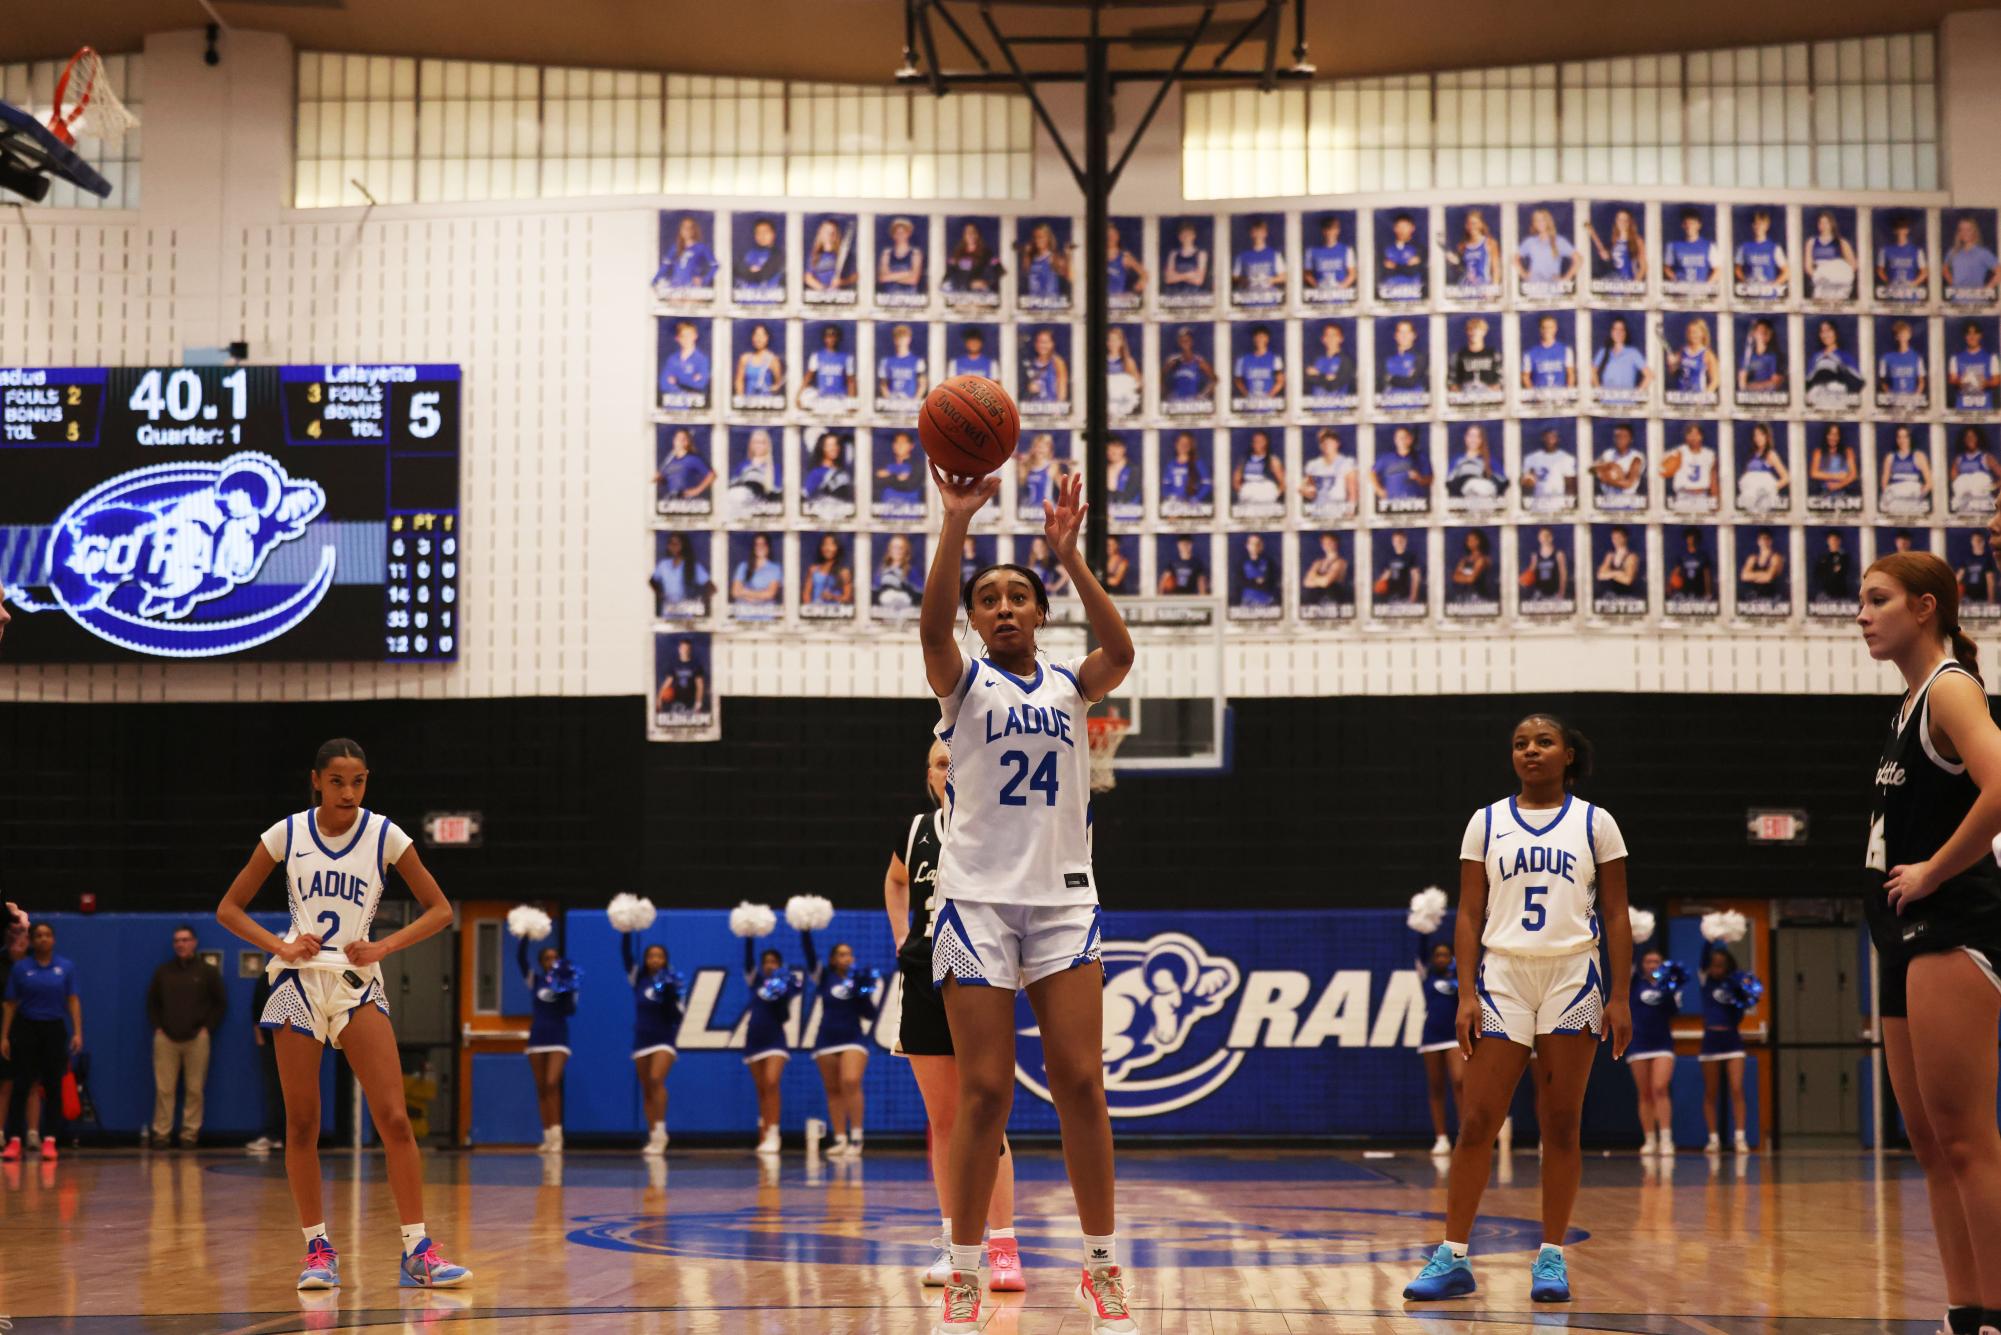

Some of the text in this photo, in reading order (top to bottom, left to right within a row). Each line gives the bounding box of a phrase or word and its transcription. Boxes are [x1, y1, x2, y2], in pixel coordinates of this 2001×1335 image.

[5, 384, 81, 405] FOULS 2
[129, 367, 246, 421] 40.1
[324, 403, 382, 419] BONUS
[328, 385, 383, 402] FOULS
[4, 424, 37, 440] TOL
[5, 406, 63, 422] BONUS
[307, 420, 322, 439] 4
[408, 391, 441, 438] 5
[936, 395, 986, 447] SPALDING
[137, 423, 241, 445] Quarter: 1
[985, 704, 1074, 748] LADUE
[999, 750, 1059, 807] 24
[1499, 846, 1577, 885] LADUE
[298, 870, 368, 908] LADUE
[1521, 886, 1549, 932] 5
[316, 910, 341, 951] 2
